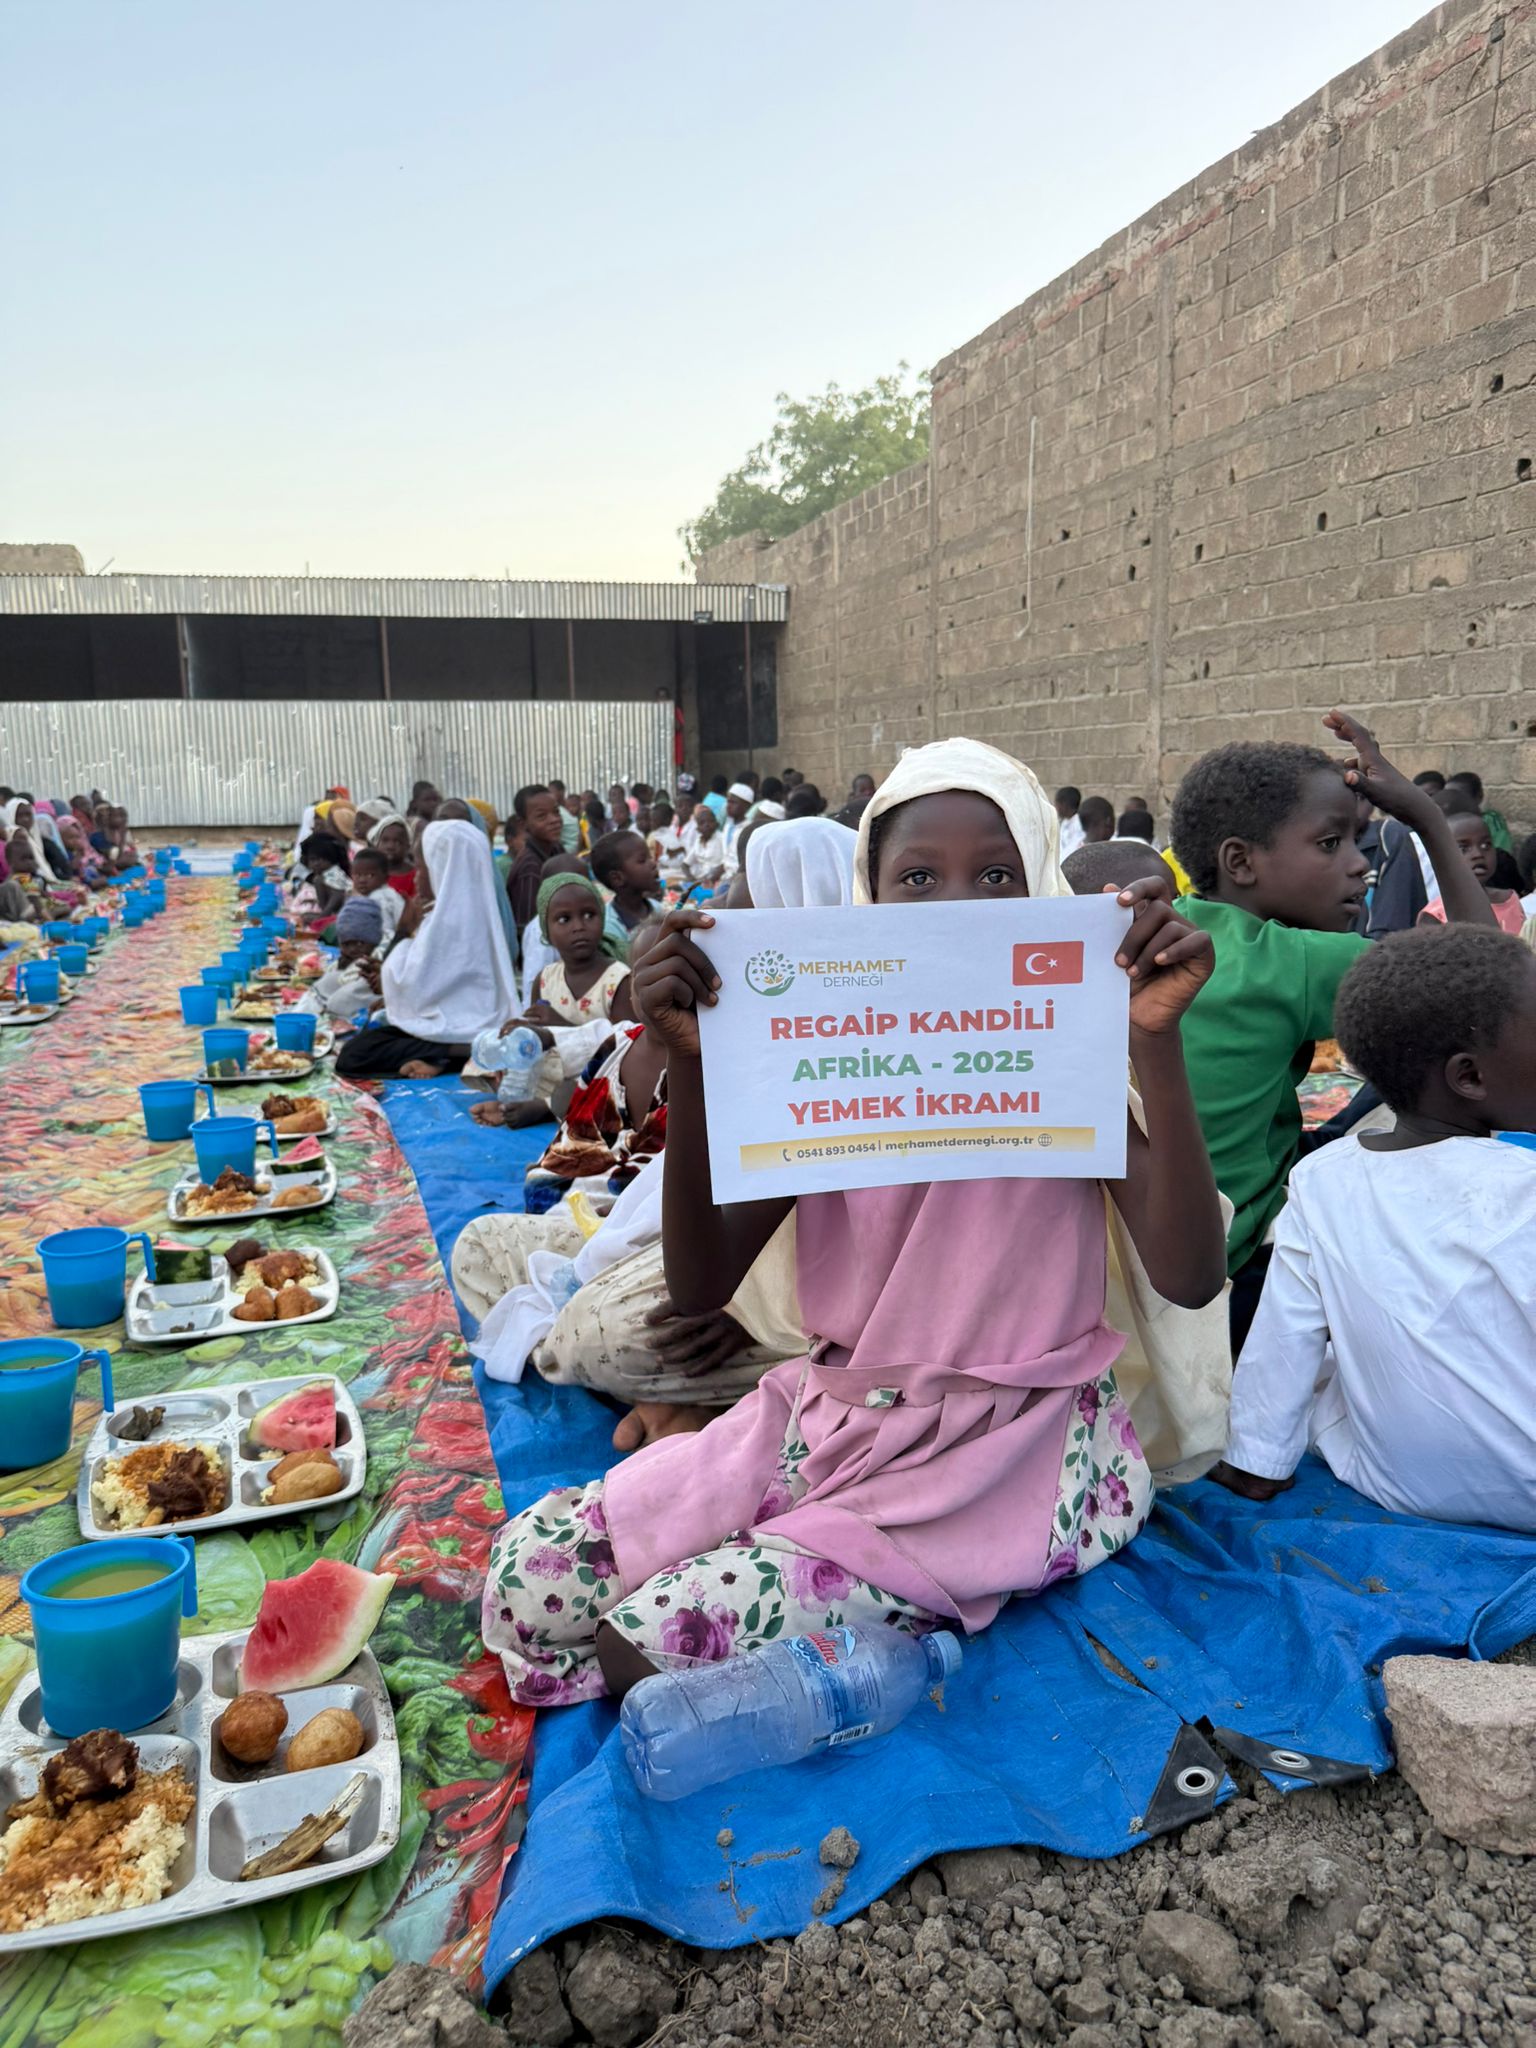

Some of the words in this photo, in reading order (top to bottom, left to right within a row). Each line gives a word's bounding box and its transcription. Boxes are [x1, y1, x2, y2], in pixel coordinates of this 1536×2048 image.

[798, 959, 907, 975] MERHAMET
[823, 972, 883, 988] DERNEĞİ
[770, 1007, 898, 1040] REGAİP
[909, 998, 1054, 1034] KANDİLİ
[792, 1047, 922, 1082] AFRİKA
[952, 1050, 1034, 1074] 2025
[787, 1095, 907, 1126] YEMEK
[914, 1087, 1041, 1117] İKRAMI
[796, 1148, 823, 1158] 0541
[825, 1145, 846, 1156] 893
[847, 1142, 876, 1153] 0454
[885, 1135, 1034, 1151] merhametdernegi.org.tr
